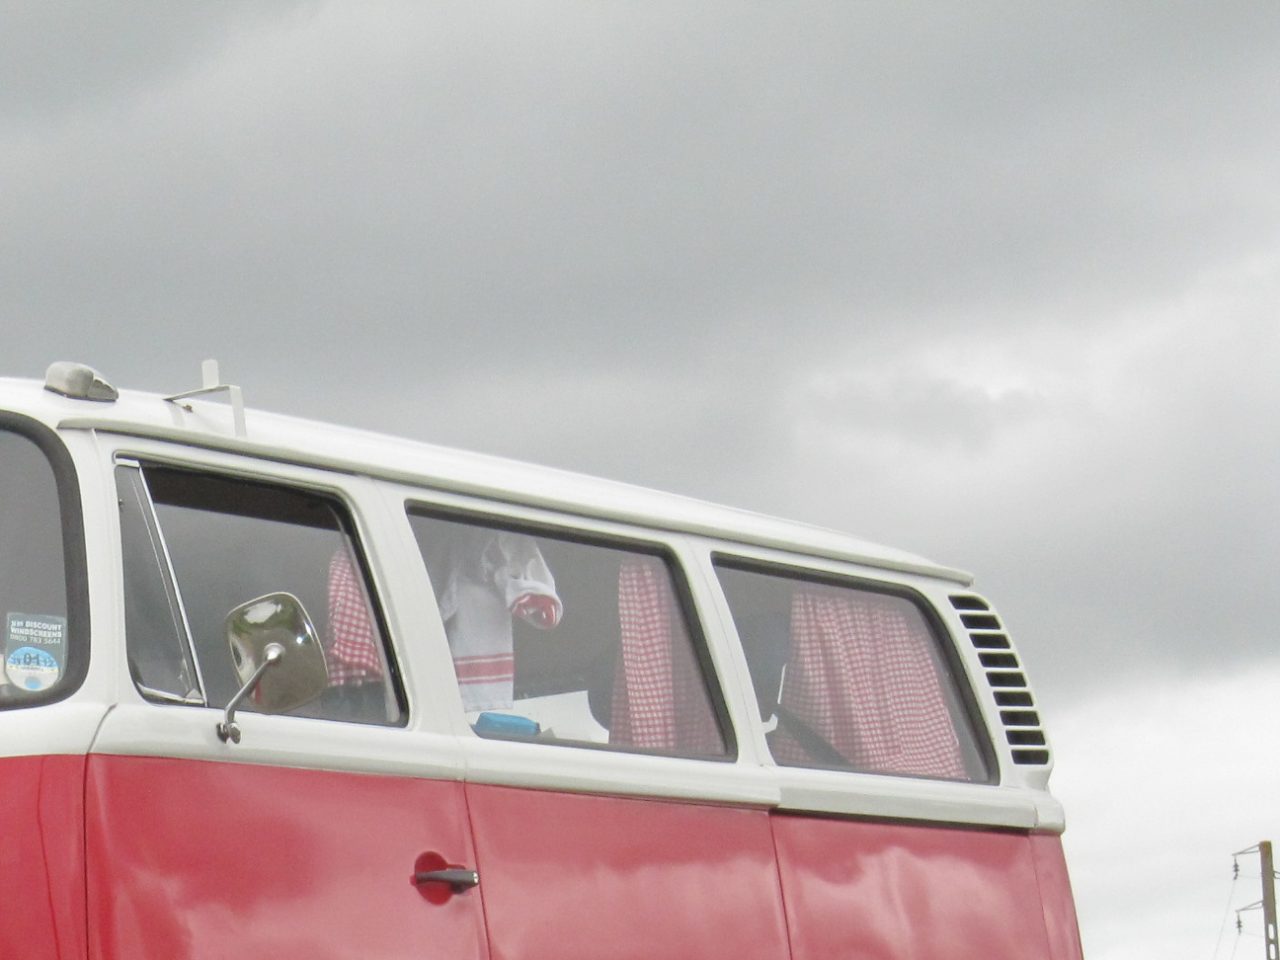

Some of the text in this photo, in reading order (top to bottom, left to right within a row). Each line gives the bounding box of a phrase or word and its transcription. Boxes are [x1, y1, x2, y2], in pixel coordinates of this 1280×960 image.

[25, 621, 62, 631] DISCOUNT
[10, 627, 62, 638] WINDSCREENS
[10, 634, 28, 642] 0800
